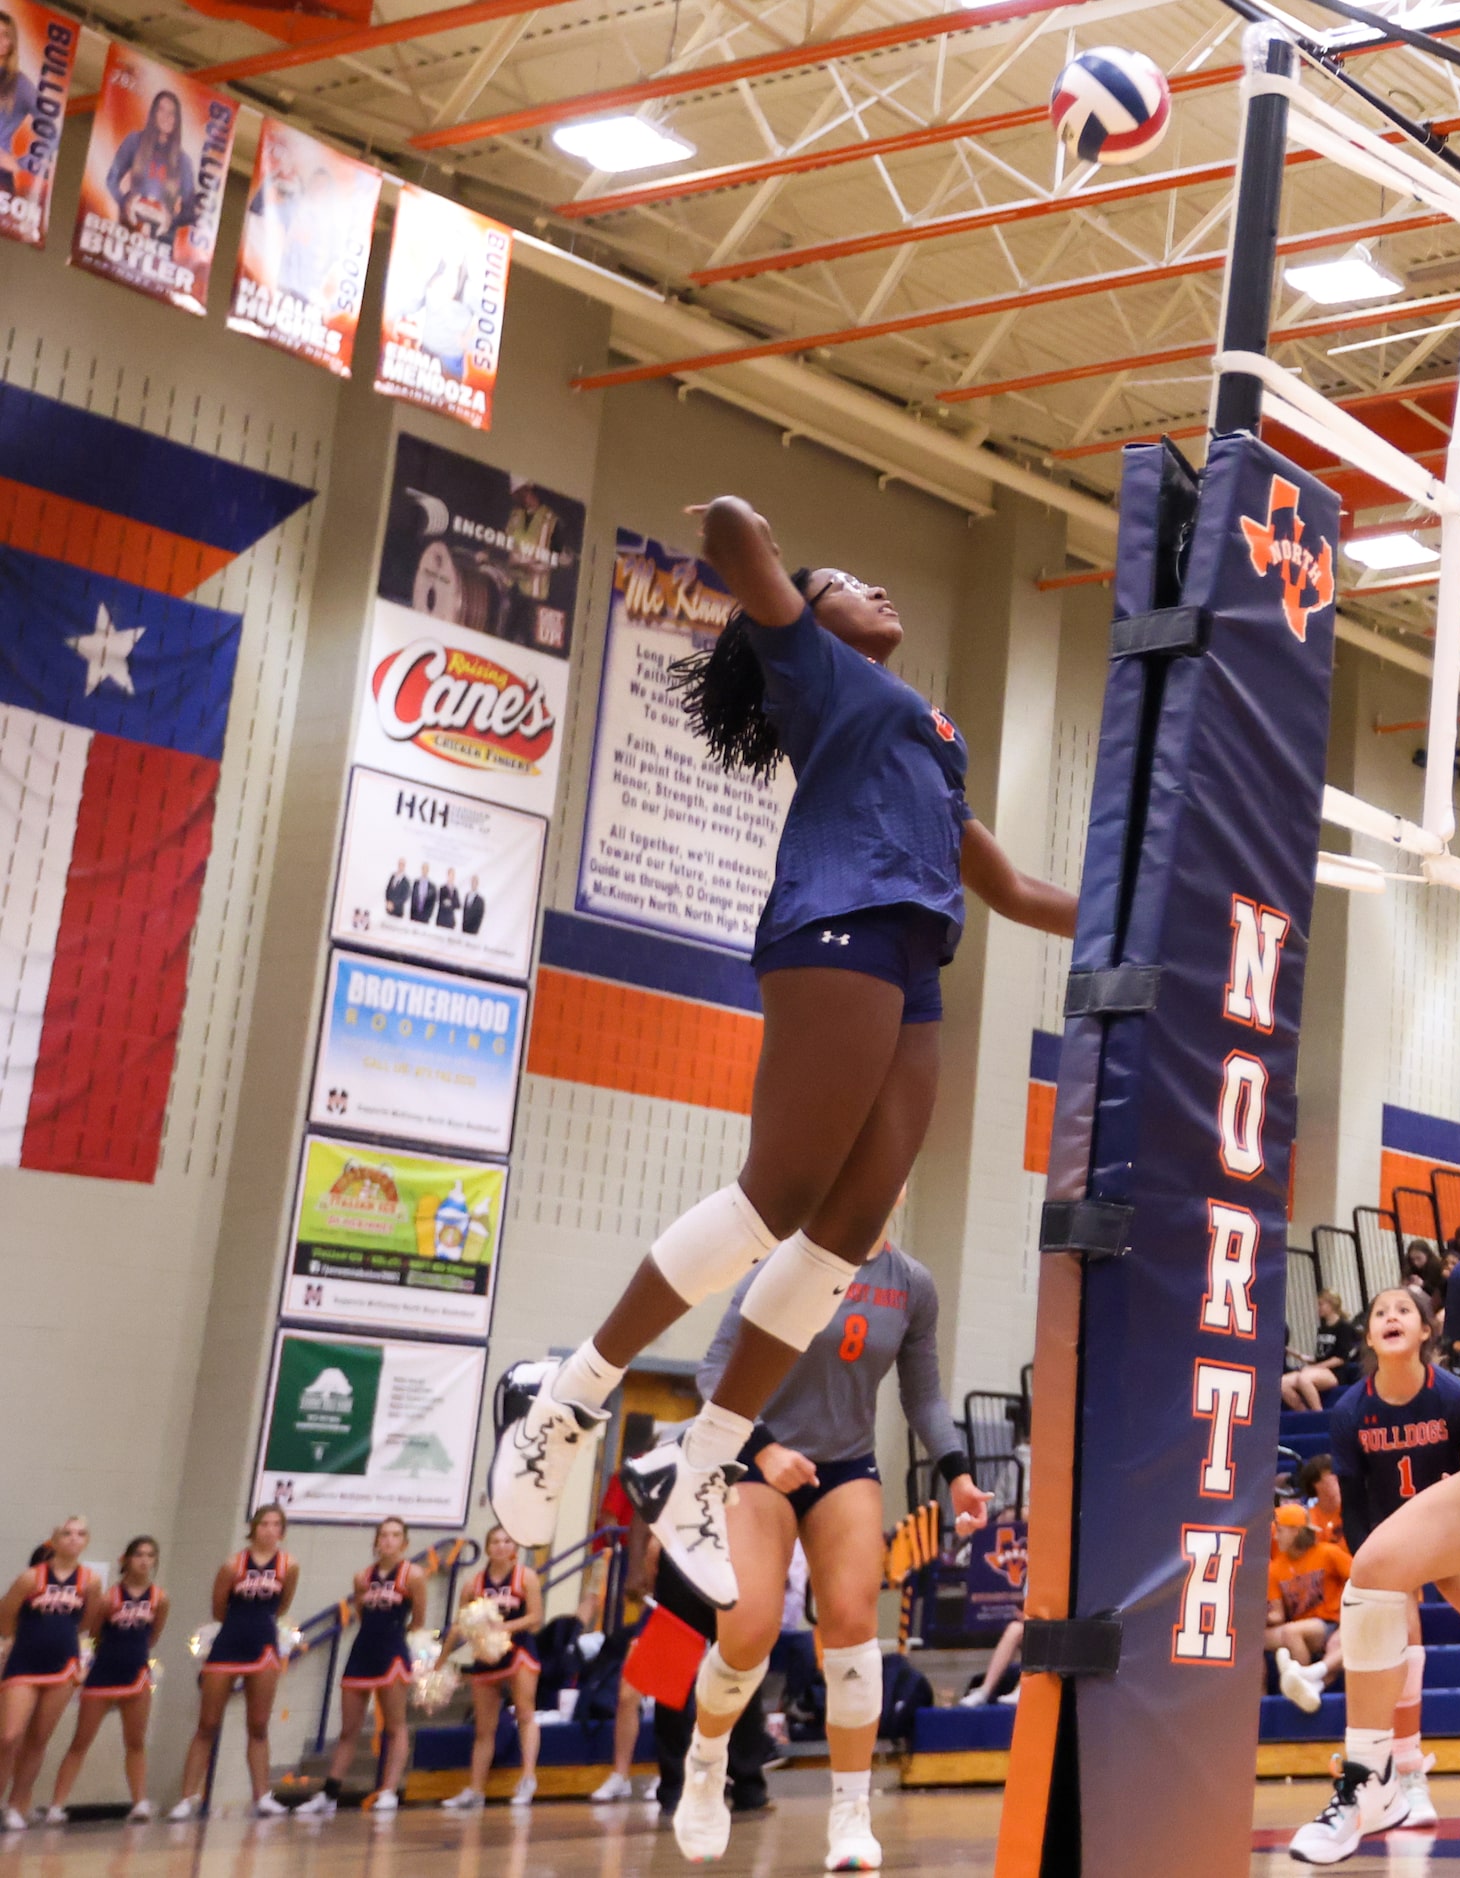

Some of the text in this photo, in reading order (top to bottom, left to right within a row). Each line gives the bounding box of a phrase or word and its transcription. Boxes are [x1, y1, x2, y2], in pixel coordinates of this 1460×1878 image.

[85, 211, 172, 259] BROOKE
[79, 230, 195, 294] BUTLER
[235, 296, 343, 354] HUGHES
[473, 232, 506, 371] BULLDOGS
[384, 341, 444, 375] EMMA
[382, 357, 487, 413] MENDOZA
[452, 515, 515, 549] ENCORE
[1269, 539, 1322, 586] NORTH
[450, 652, 508, 686] Raising
[636, 643, 664, 667] Long
[377, 640, 555, 741] Cane's
[630, 681, 647, 698] We
[644, 704, 656, 721] To
[661, 712, 679, 728] our
[627, 733, 659, 759] Faith,
[613, 769, 779, 834] Honor, Strength, and Loyalty,
[614, 750, 636, 768] Will
[640, 760, 669, 778] point
[674, 768, 692, 785] the
[696, 776, 719, 794] true
[723, 783, 754, 804] North
[621, 791, 638, 809] On
[641, 799, 661, 814] our
[663, 806, 708, 832] journey
[711, 822, 741, 842] every
[599, 839, 642, 865] Toward
[646, 856, 665, 870] our
[669, 860, 708, 885] future,
[711, 875, 732, 889] one
[610, 824, 771, 882] All together, we'll endeavor,
[590, 857, 621, 879] Guide
[624, 870, 636, 883] us
[640, 872, 683, 897] through,
[697, 887, 734, 910] Orange
[736, 899, 754, 914] and
[593, 879, 644, 909] McKinney
[648, 895, 681, 917] North,
[684, 905, 714, 924] North
[716, 914, 740, 933] High
[348, 970, 510, 1034] BROTHERHOOD
[346, 1007, 506, 1055] ROOFING
[1171, 893, 1290, 1667] NORTH
[838, 1313, 868, 1363] 8
[1358, 1418, 1449, 1453] BULLDOGS
[1398, 1455, 1416, 1498] 1
